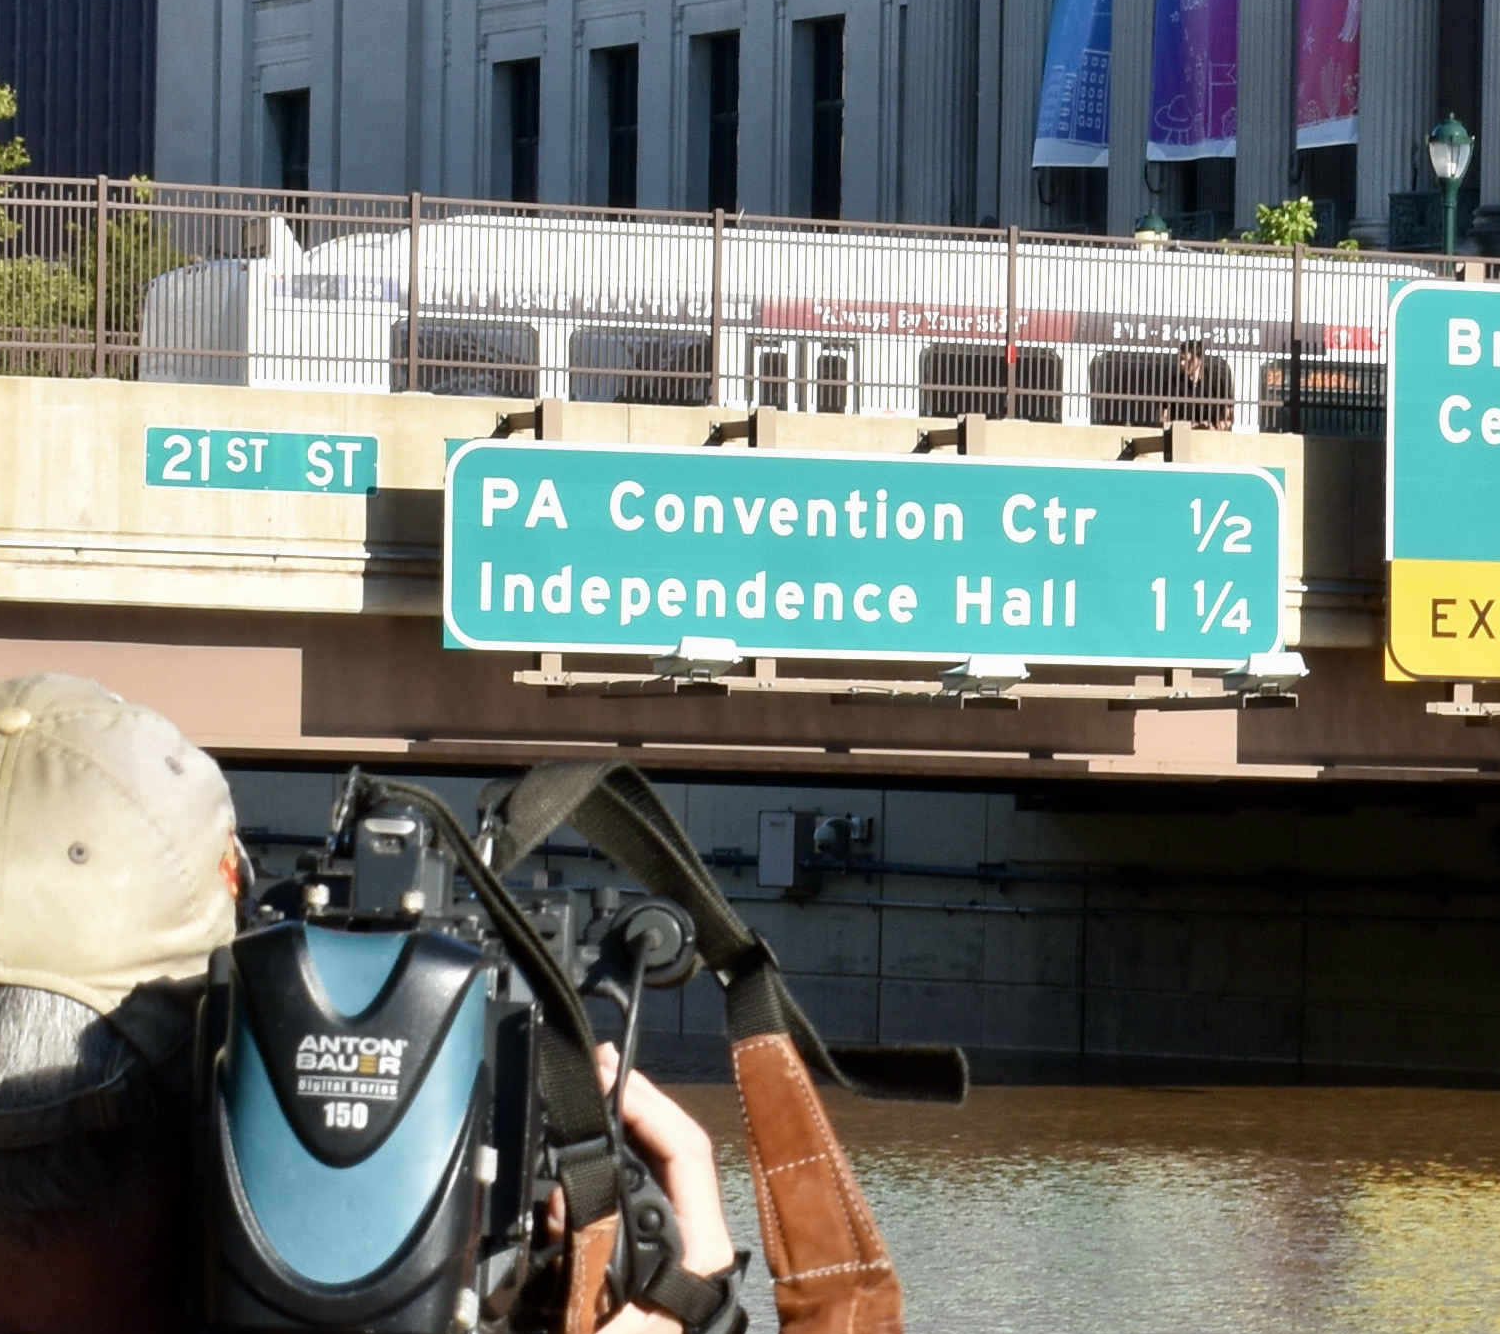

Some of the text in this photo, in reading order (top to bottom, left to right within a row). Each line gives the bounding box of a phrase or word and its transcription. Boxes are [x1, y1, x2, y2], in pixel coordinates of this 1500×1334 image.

[305, 440, 362, 488] ST
[481, 476, 569, 530] PA
[609, 480, 964, 542] Convention
[1001, 493, 1098, 546] Ctr
[479, 561, 918, 627] Independence
[955, 575, 1076, 628] Hall
[298, 1034, 404, 1057] ANTON
[298, 1078, 398, 1095] Digital Series
[323, 1101, 369, 1129] 150
